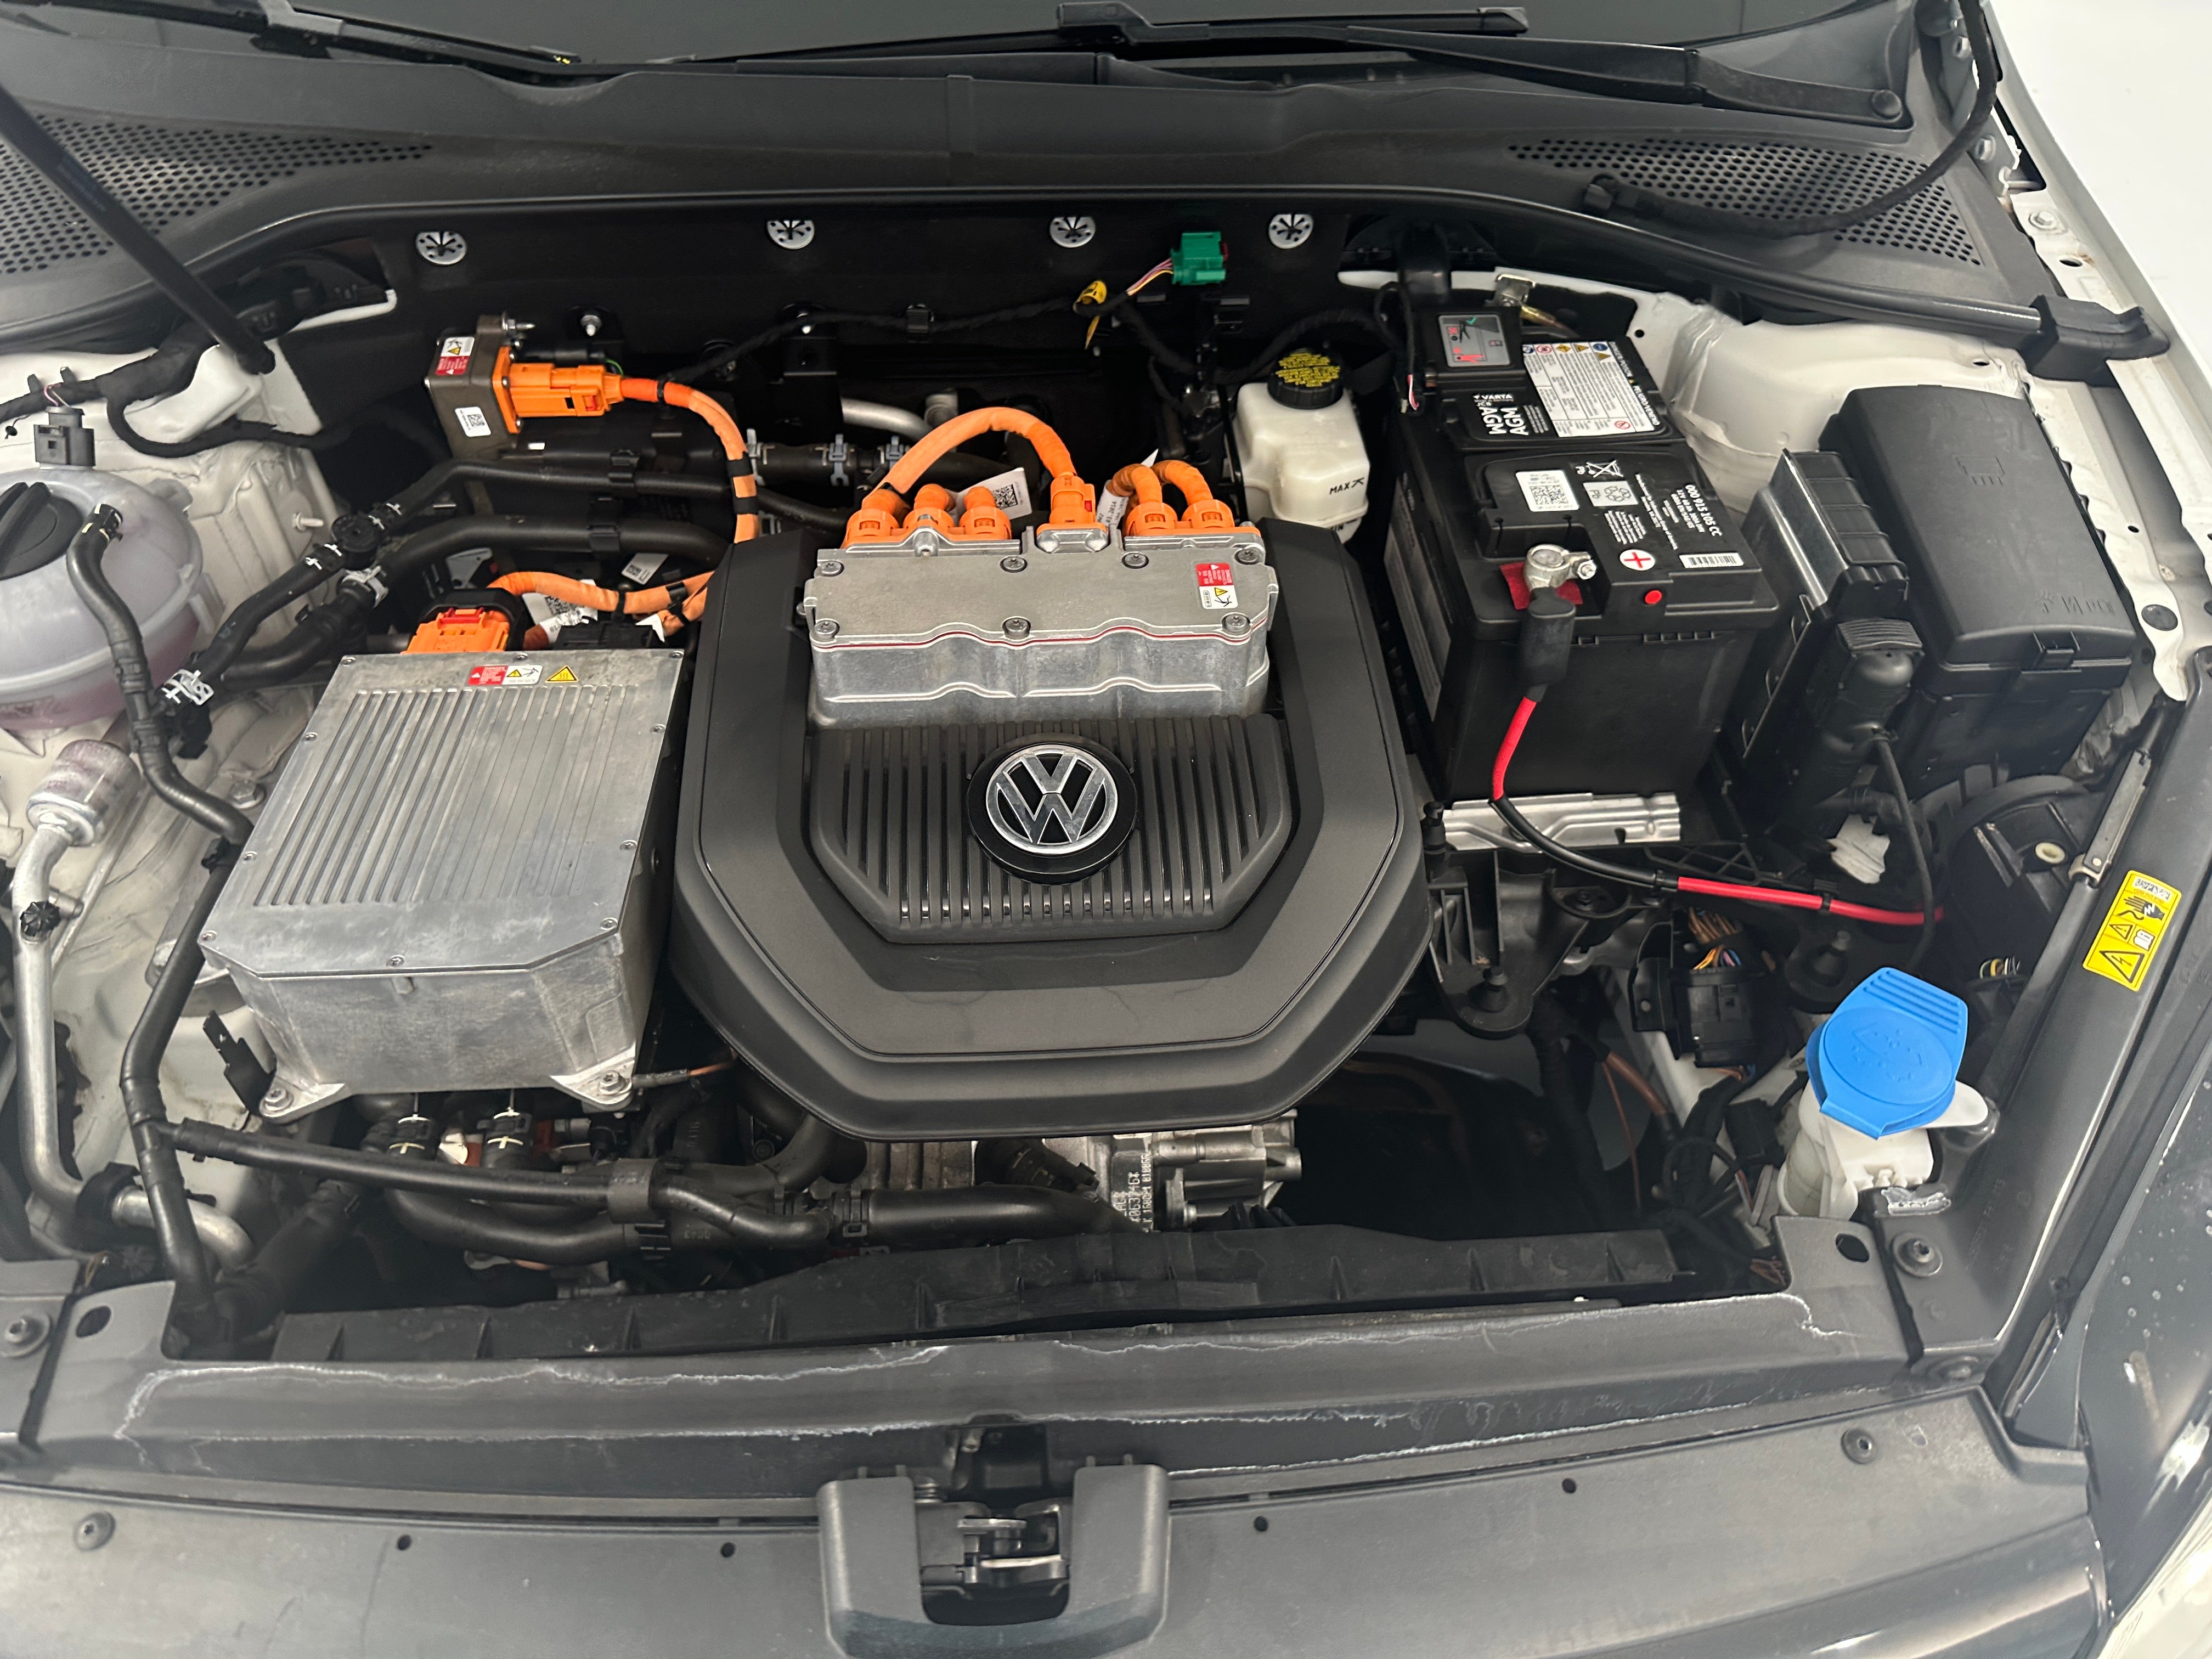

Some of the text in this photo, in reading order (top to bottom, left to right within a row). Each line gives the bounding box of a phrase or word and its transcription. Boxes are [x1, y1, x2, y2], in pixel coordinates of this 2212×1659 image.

[1479, 407, 1506, 435] AGM
[1500, 407, 1529, 435] AGM
[1330, 482, 1350, 494] MAX
[1106, 501, 1116, 523] 03.2014
[1685, 484, 1722, 537] 000 915 105 CC
[986, 745, 1118, 854] VW
